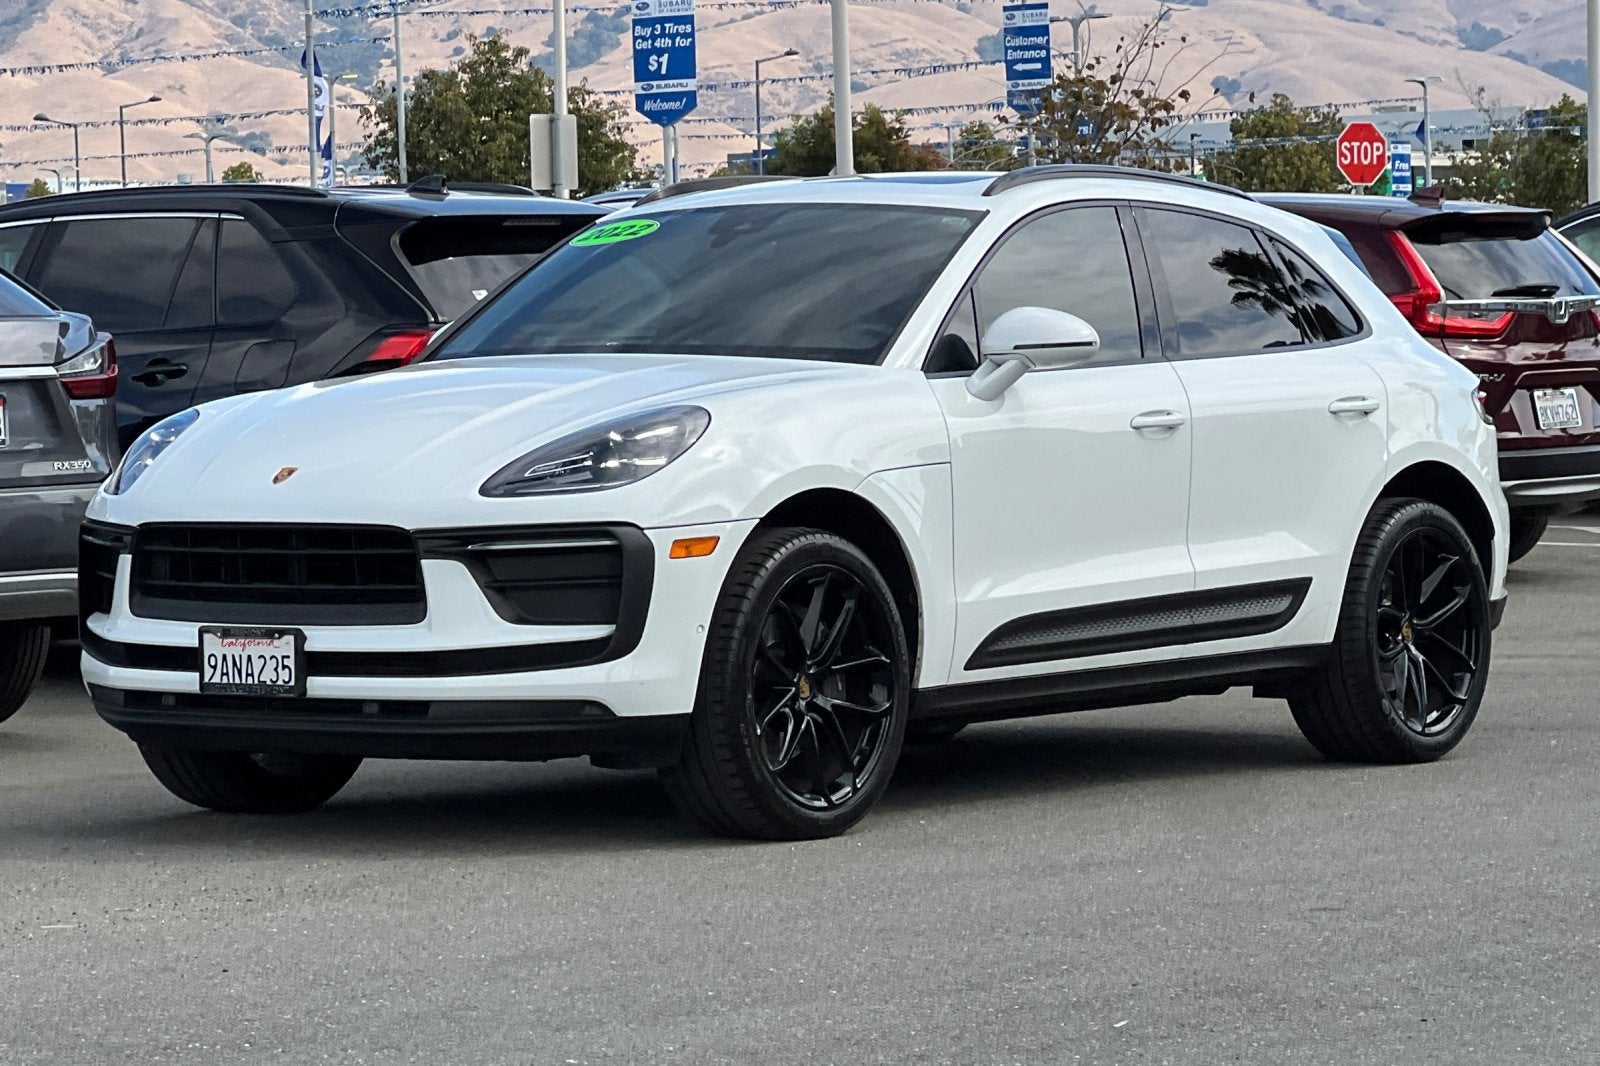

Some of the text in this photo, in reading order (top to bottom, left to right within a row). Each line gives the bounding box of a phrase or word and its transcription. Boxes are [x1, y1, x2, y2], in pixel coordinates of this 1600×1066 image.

[634, 23, 692, 38] Buy 3 Tires
[635, 36, 693, 50] Get 4th for
[1005, 36, 1048, 47] Customer
[1007, 49, 1047, 60] Entrance
[648, 53, 669, 74] $1
[655, 82, 688, 90] SUBARU
[644, 97, 687, 111] Welcome!
[1341, 141, 1384, 165] STOP
[576, 224, 655, 242] 2022
[221, 638, 275, 653] California
[207, 653, 292, 685] 9ANA235
